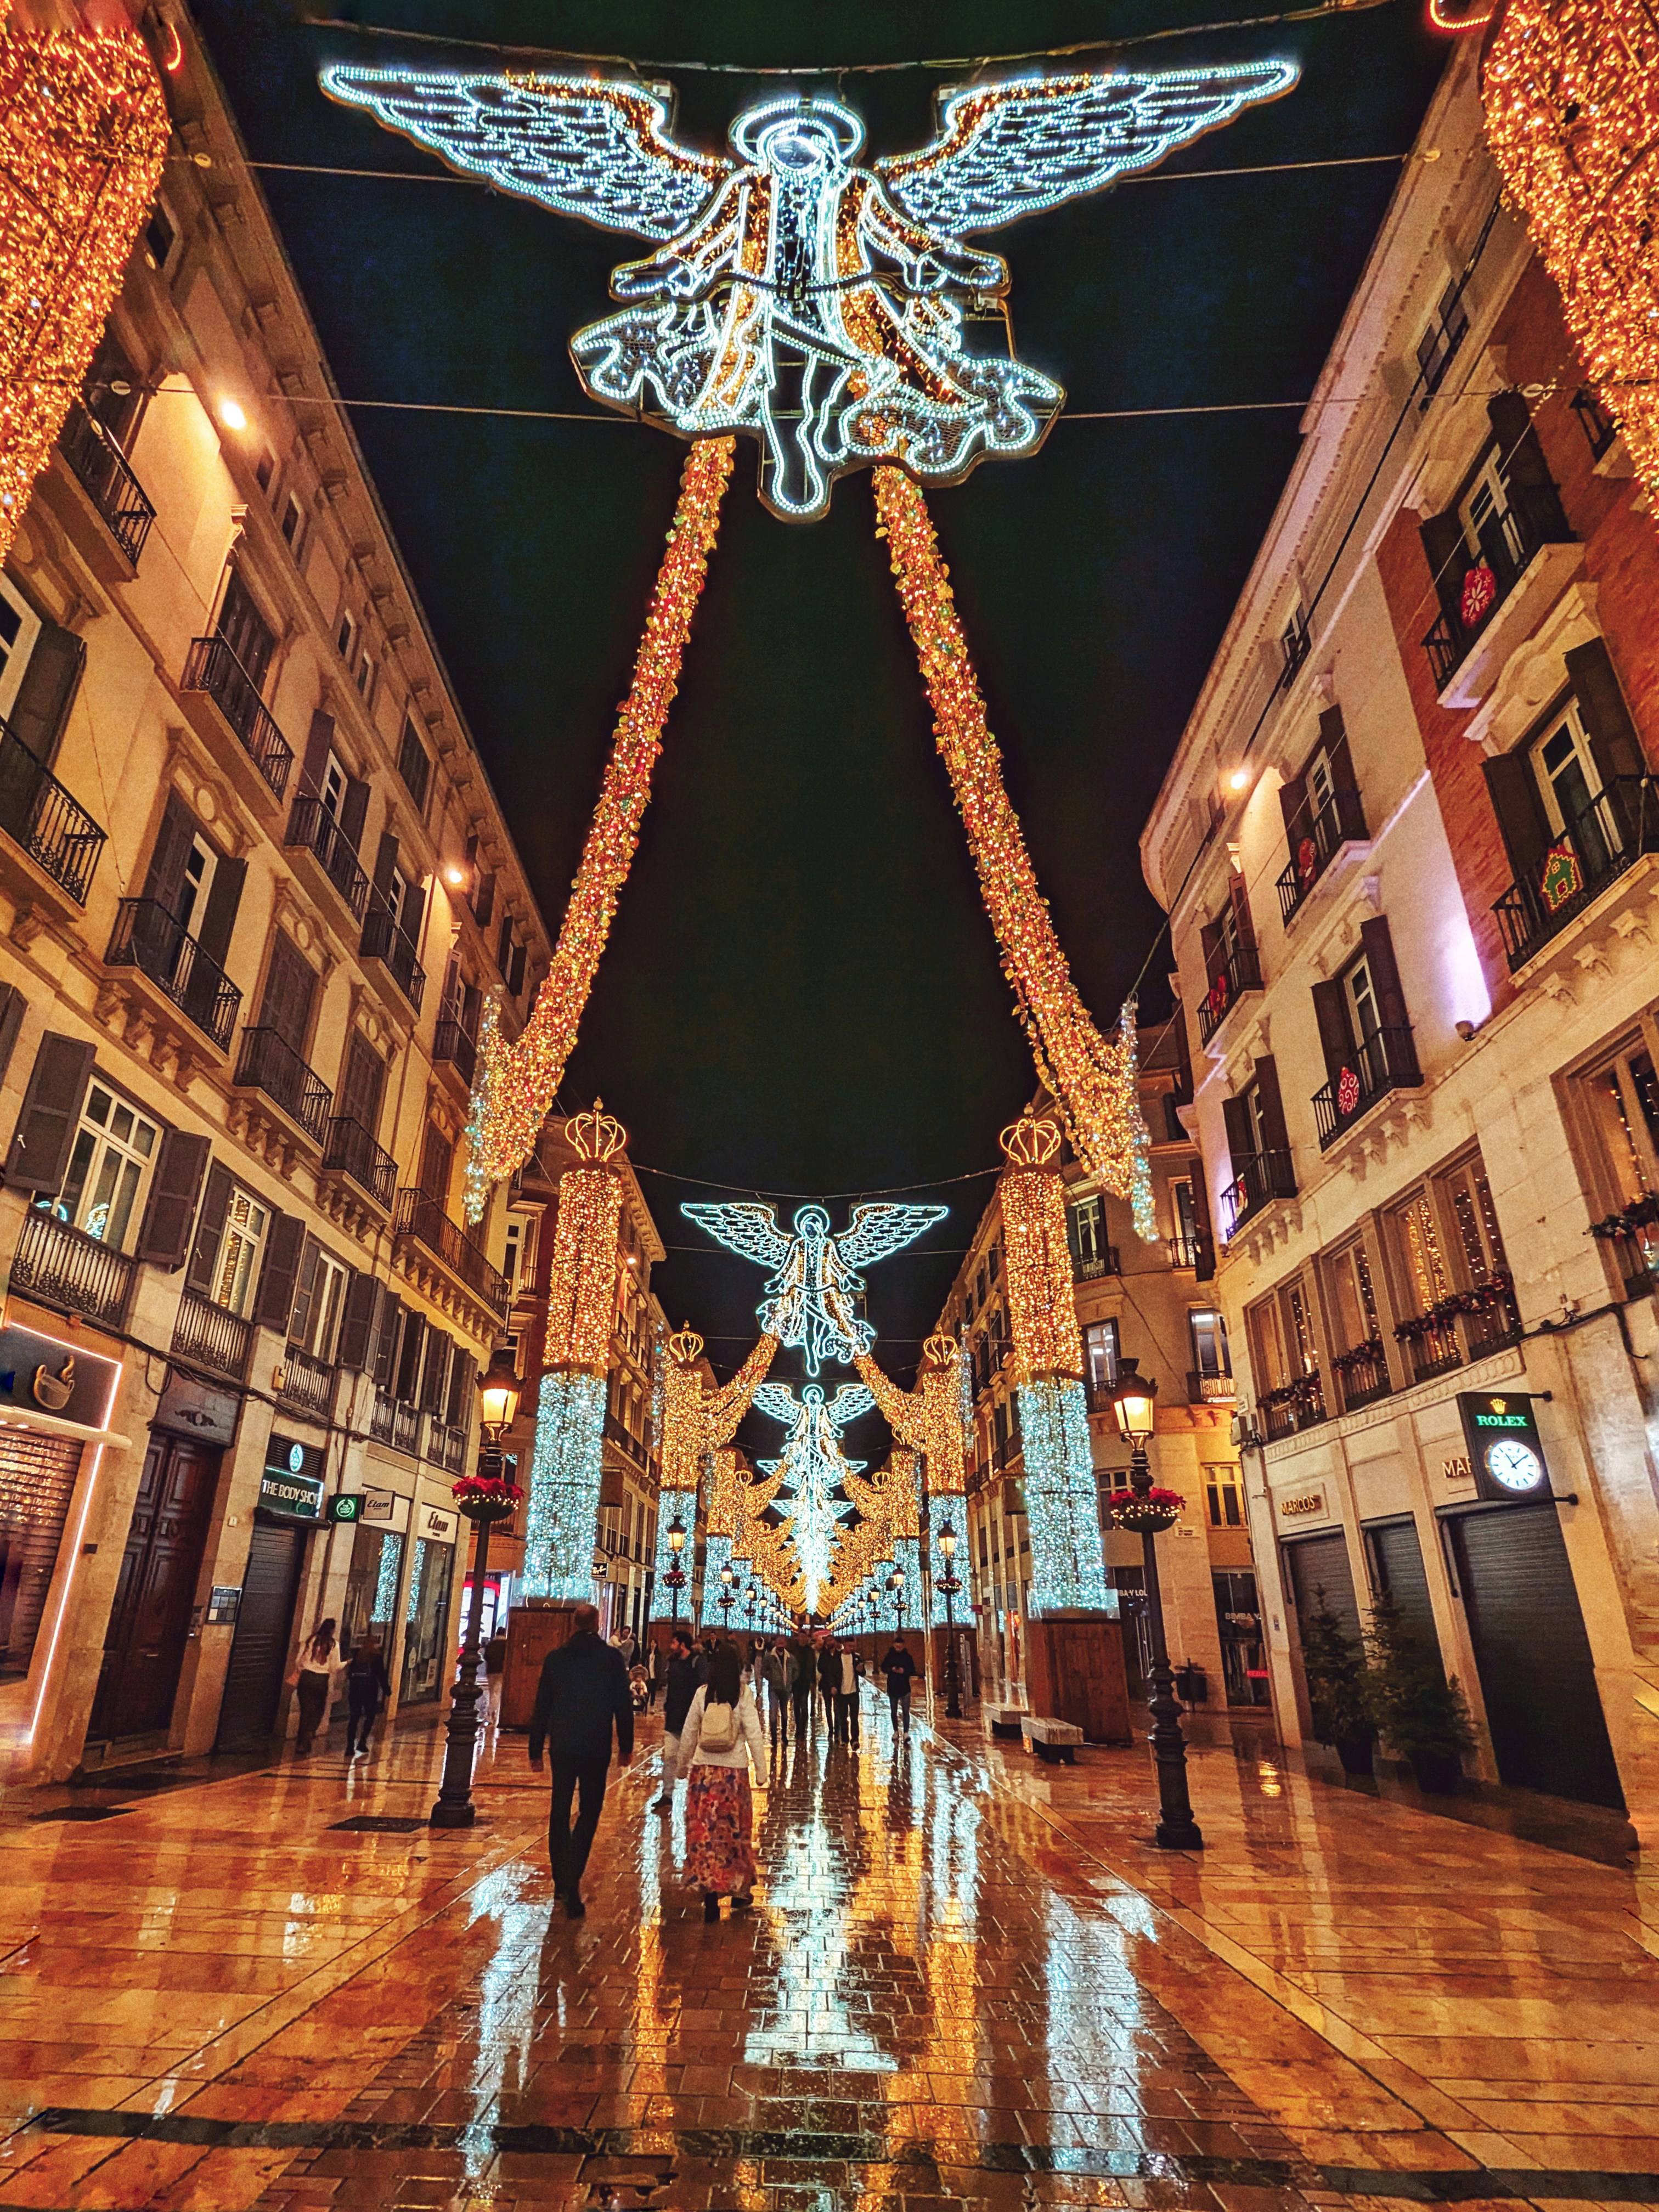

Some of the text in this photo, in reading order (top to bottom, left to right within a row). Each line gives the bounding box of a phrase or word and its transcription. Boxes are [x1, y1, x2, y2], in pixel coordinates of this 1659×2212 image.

[1476, 1415, 1528, 1426] ROLEX
[262, 1480, 279, 1496] THE
[278, 1485, 301, 1501] BODY
[367, 1499, 390, 1508] Etam
[1282, 1495, 1315, 1515] MARCOS
[428, 1511, 449, 1532] Etam
